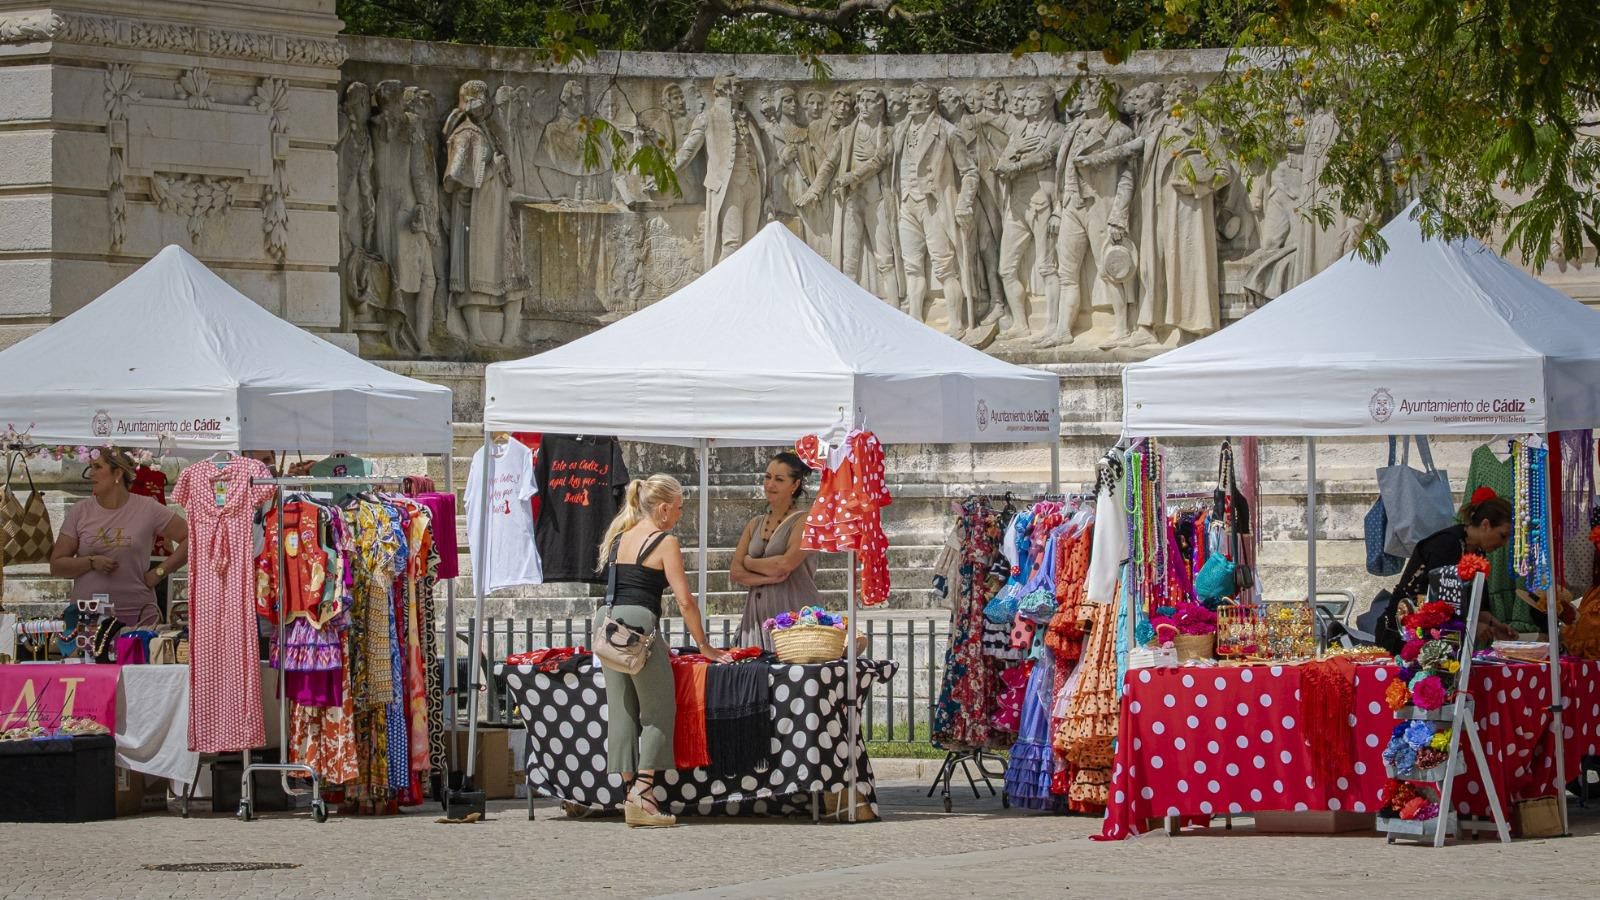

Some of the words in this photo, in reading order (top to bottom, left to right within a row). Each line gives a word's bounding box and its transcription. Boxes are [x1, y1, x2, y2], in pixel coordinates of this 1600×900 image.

[1400, 400, 1474, 415] Ayuntamiento
[1476, 400, 1490, 412] de
[1492, 399, 1526, 413] Cádiz
[991, 409, 1025, 424] Ayuntamiento
[1026, 410, 1033, 422] de
[1034, 410, 1049, 422] Cádiz
[117, 420, 178, 434] Ayuntamiento
[180, 420, 192, 432] de
[193, 419, 221, 431] Cádiz
